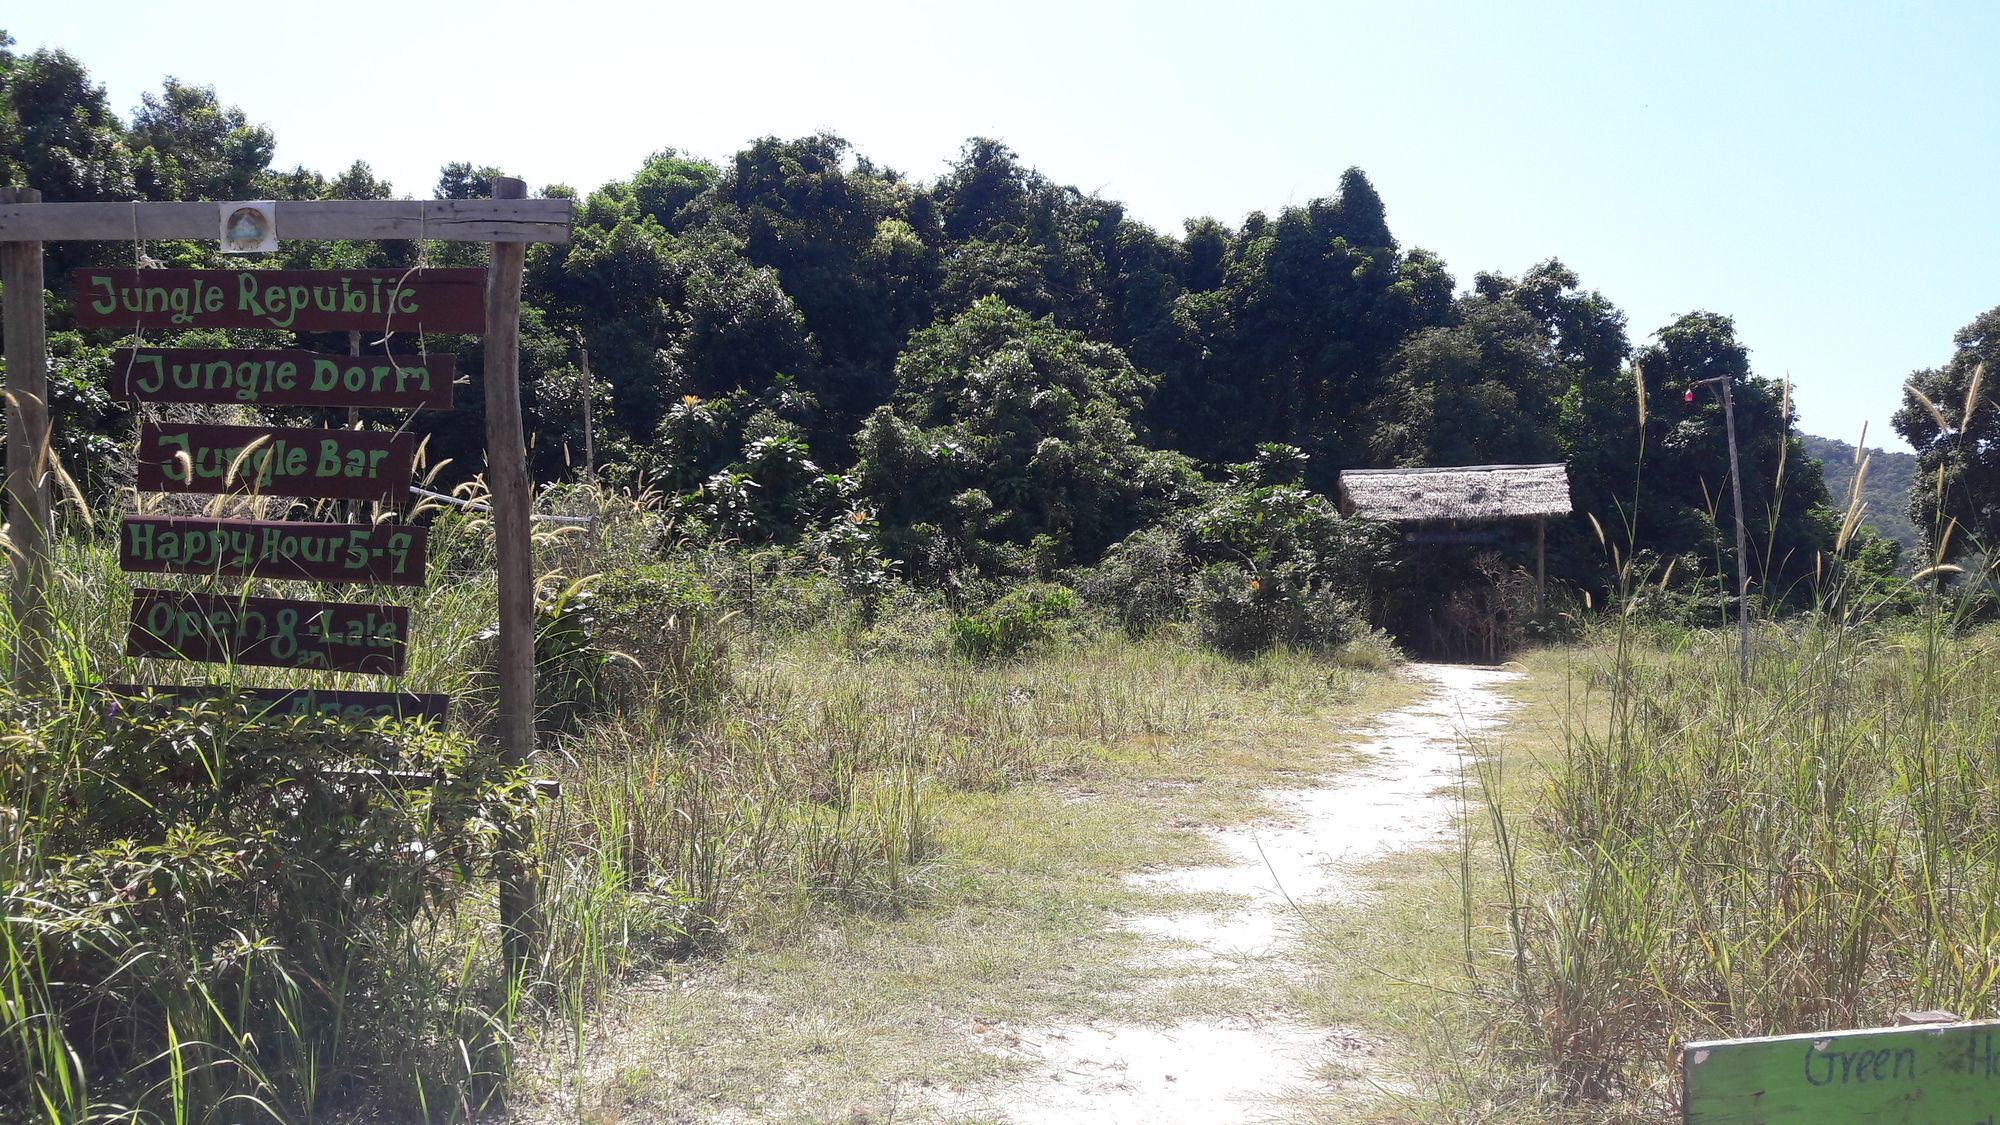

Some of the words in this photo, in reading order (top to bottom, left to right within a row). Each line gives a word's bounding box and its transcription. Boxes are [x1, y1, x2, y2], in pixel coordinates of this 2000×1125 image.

[92, 276, 224, 324] Jungle
[238, 272, 420, 328] Republic
[135, 354, 298, 400] Jungle
[310, 359, 431, 393] Dorm
[158, 432, 307, 488] Jungle
[315, 439, 389, 479] Bar
[128, 523, 255, 568] Happy
[261, 527, 344, 564] Hour
[147, 602, 267, 659] Open
[1804, 1038, 1916, 1087] Green
